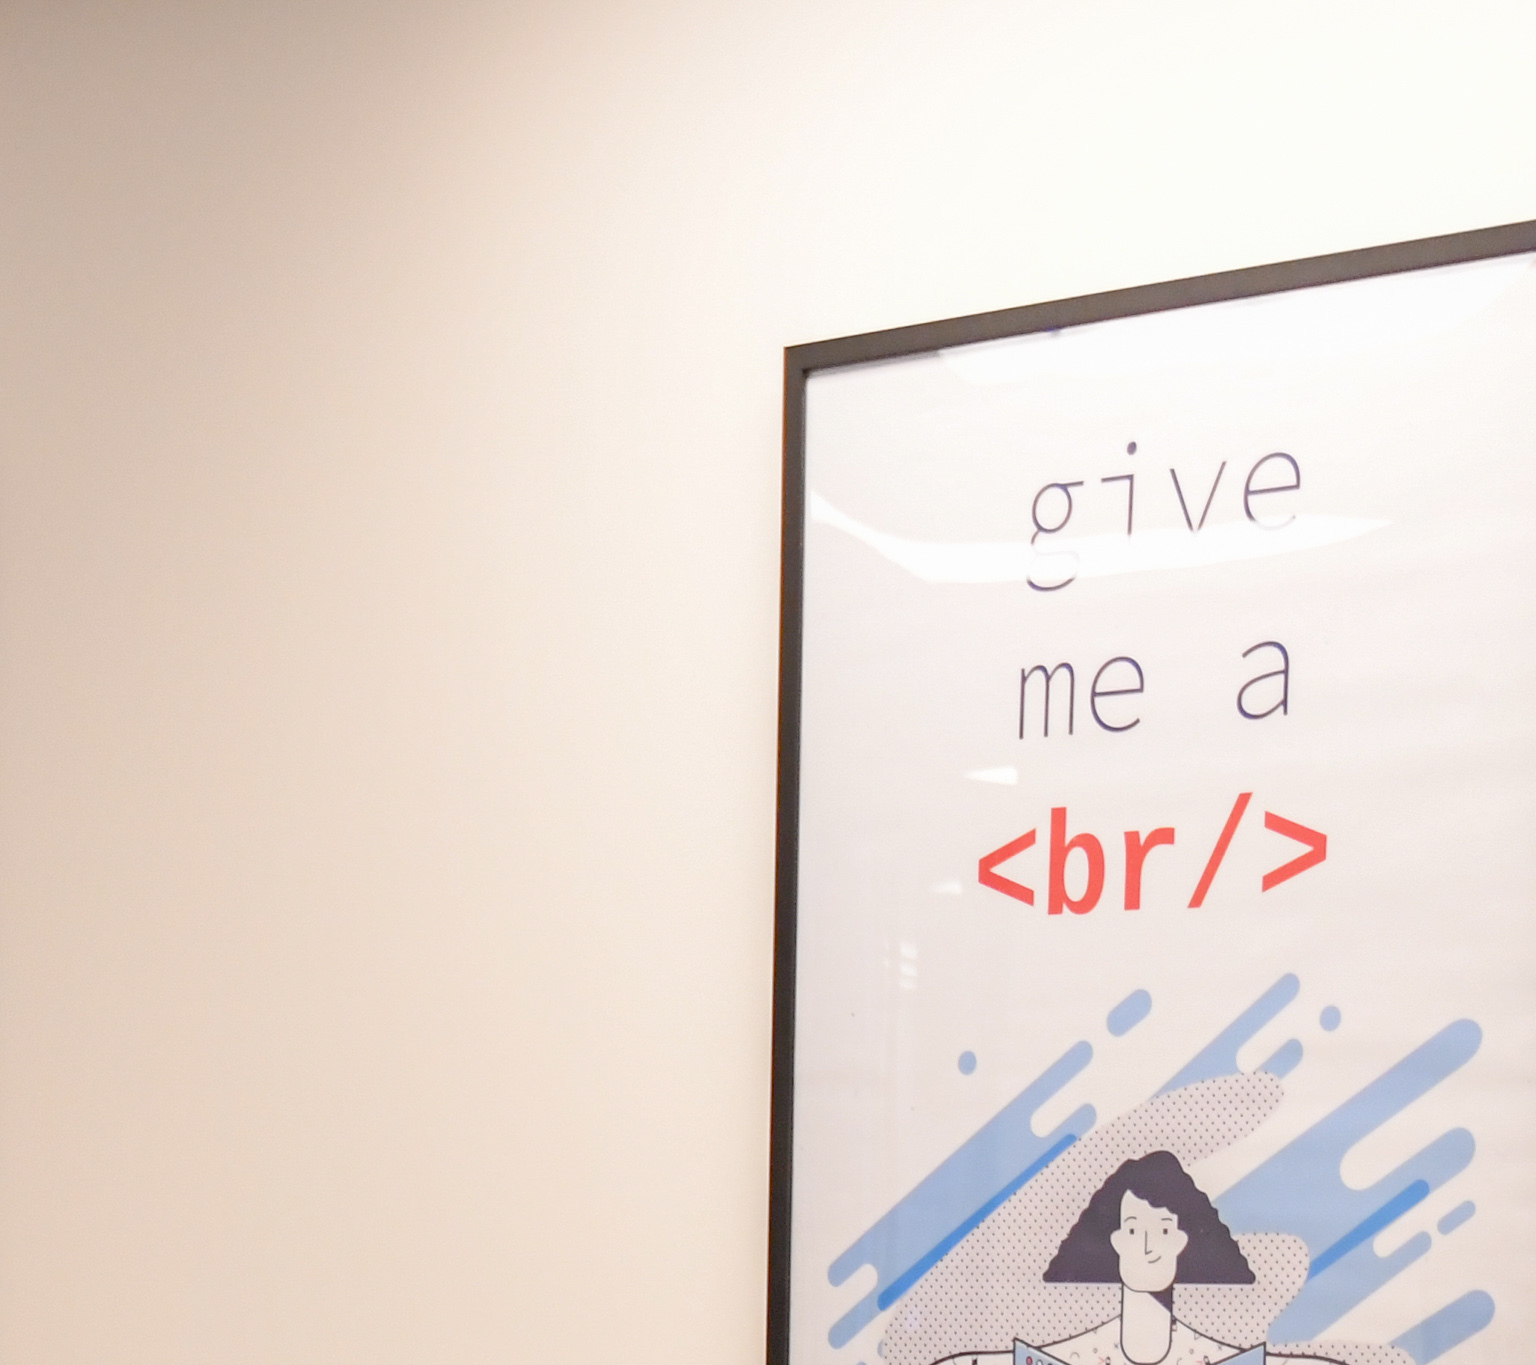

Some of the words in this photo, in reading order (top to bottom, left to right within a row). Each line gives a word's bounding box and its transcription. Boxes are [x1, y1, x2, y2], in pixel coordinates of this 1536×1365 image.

[1026, 440, 1302, 592] give
[1018, 655, 1145, 740] me
[1236, 640, 1291, 721] a
[977, 791, 1329, 916] <br/>
